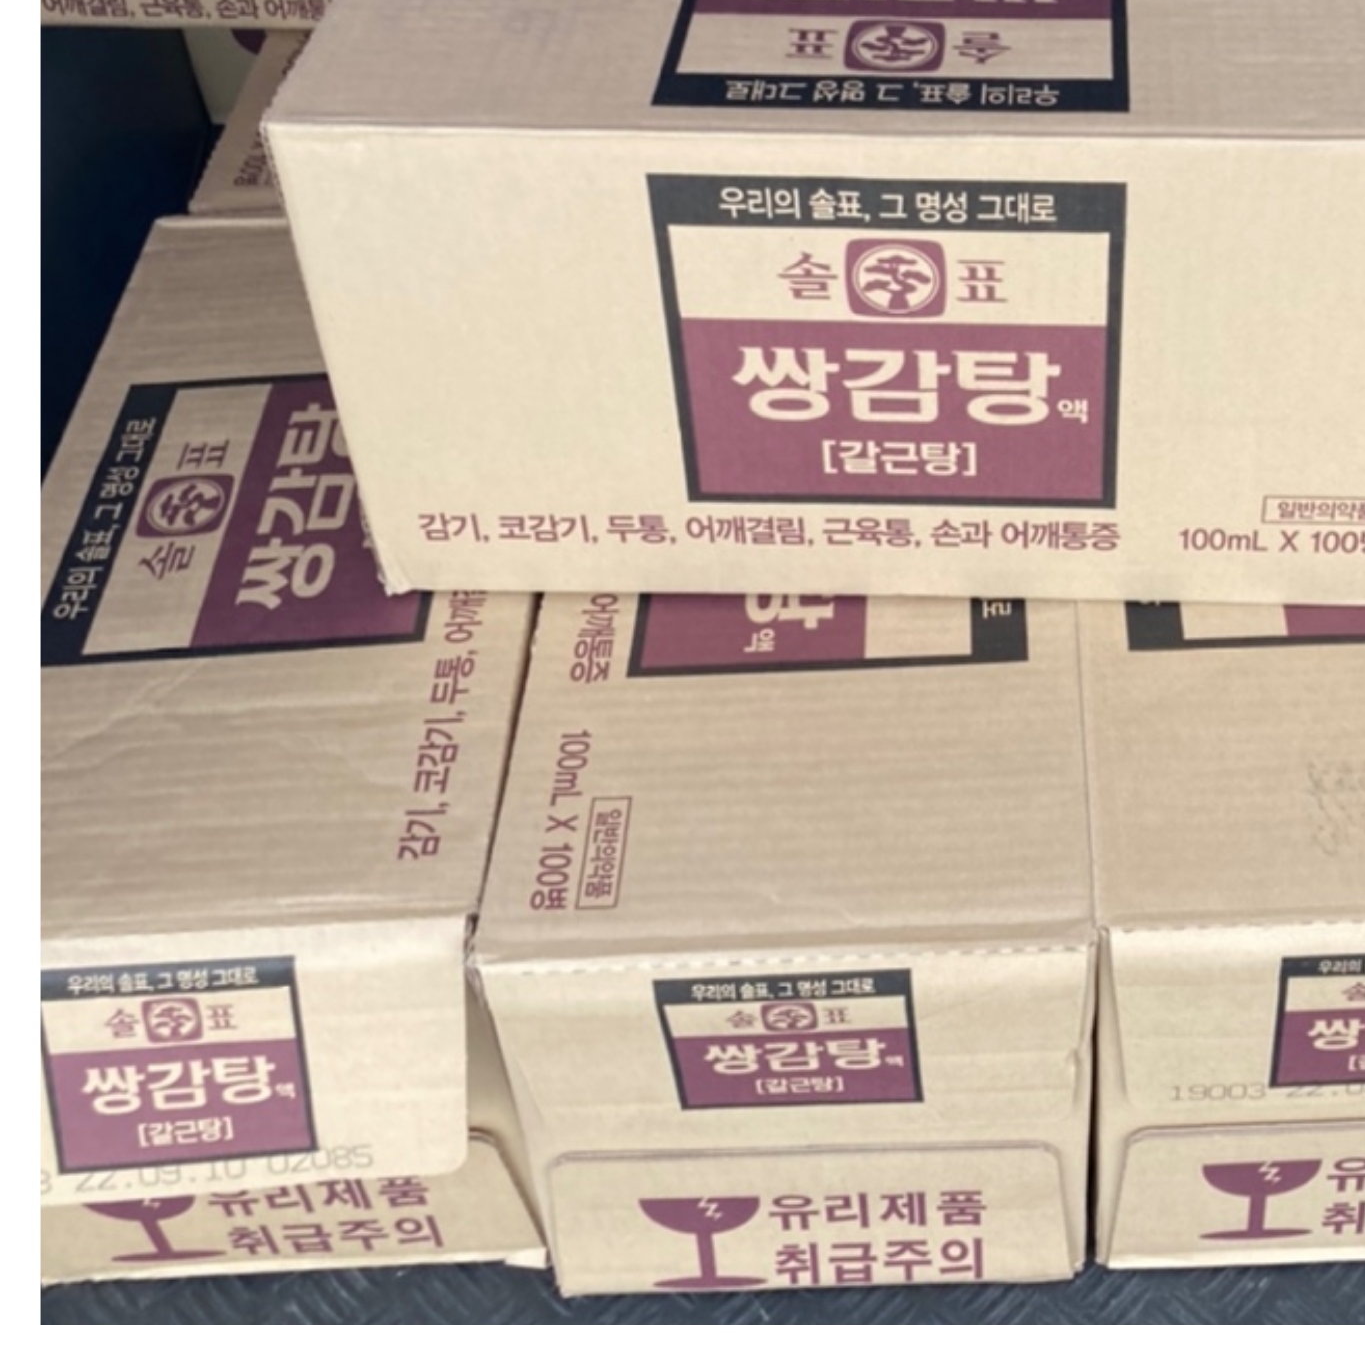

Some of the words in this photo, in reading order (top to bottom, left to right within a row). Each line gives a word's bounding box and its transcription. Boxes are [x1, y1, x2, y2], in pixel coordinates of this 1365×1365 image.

[786, 28, 838, 59] 표
[953, 30, 1012, 65] 솔
[726, 80, 804, 100] 그대로
[812, 81, 865, 103] 명성
[876, 83, 900, 101] 그
[980, 83, 1060, 106] 우리의
[719, 188, 801, 219] 우리의
[808, 189, 870, 223] 솔표,
[879, 193, 908, 219] 그
[915, 191, 968, 223] 명성
[977, 192, 1057, 223] 그대로
[777, 252, 838, 302] 솔
[955, 258, 1008, 304] 표
[731, 344, 1061, 427] 쌍감탕
[1058, 397, 1089, 423] 액
[821, 440, 976, 478] [갈근탕]
[418, 513, 490, 543] 감기,
[498, 514, 598, 545] 코감기,
[606, 516, 676, 545] 두통,
[685, 516, 814, 548] 어깨결림,
[822, 518, 921, 550] 근육통,
[930, 520, 993, 550] 손과
[1001, 520, 1120, 551] 어깨통증
[1178, 528, 1268, 552] 100mL
[1279, 530, 1299, 552] X
[430, 650, 476, 705] 두통,
[412, 710, 466, 796] 코감기,
[549, 729, 592, 807] 100mL
[397, 801, 448, 861] 감기,
[531, 841, 575, 912] 100병
[105, 1007, 140, 1040] 솔
[206, 1002, 238, 1031] 표
[703, 1037, 886, 1074] 쌍감탕
[82, 1055, 277, 1115] 쌍감탕
[138, 1118, 233, 1148] [갈근탕]
[768, 1191, 989, 1230] 유리제품
[226, 1215, 445, 1256] 취급주의
[774, 1238, 985, 1285] 취급주의
